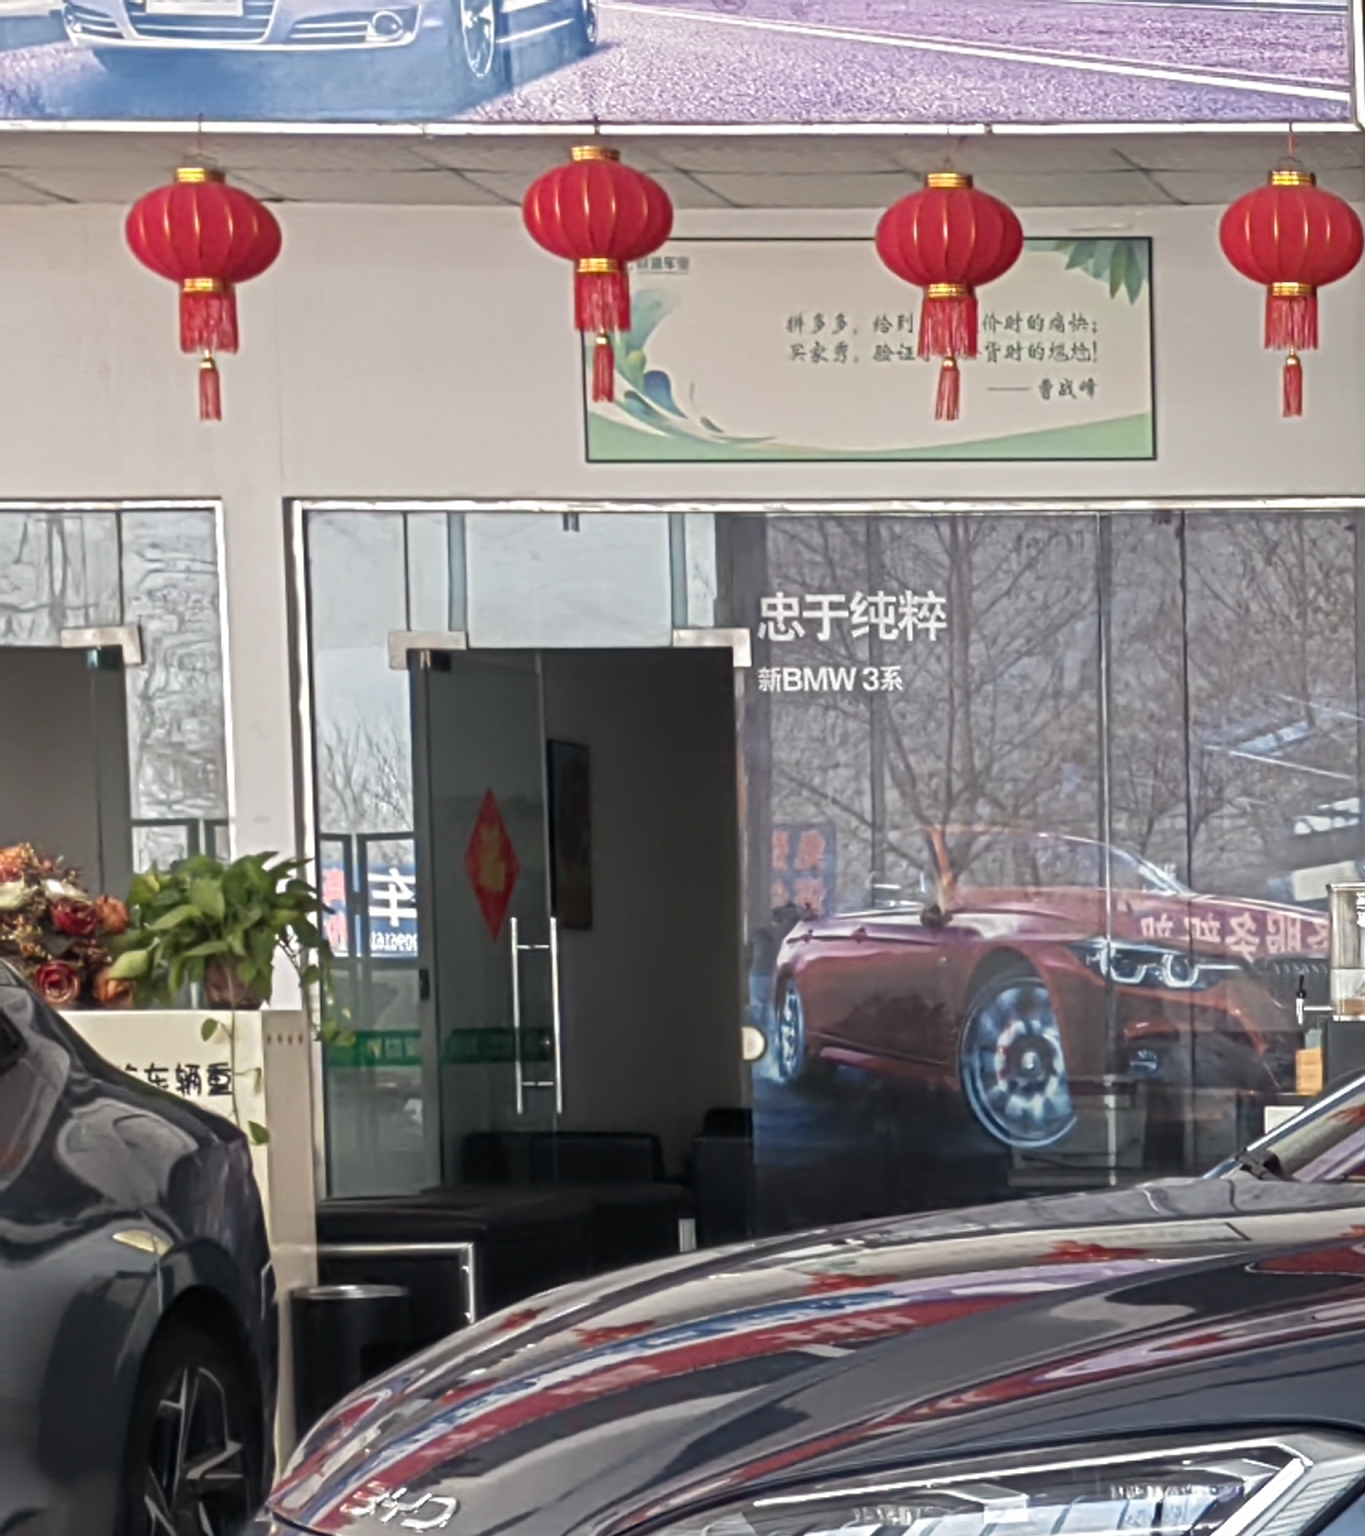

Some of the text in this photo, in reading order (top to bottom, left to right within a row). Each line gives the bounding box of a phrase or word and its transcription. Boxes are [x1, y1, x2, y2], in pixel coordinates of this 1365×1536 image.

[757, 590, 949, 642] 忠于纯粹
[758, 665, 903, 692] 新BMW 3系
[123, 1062, 234, 1098] 车辆重
